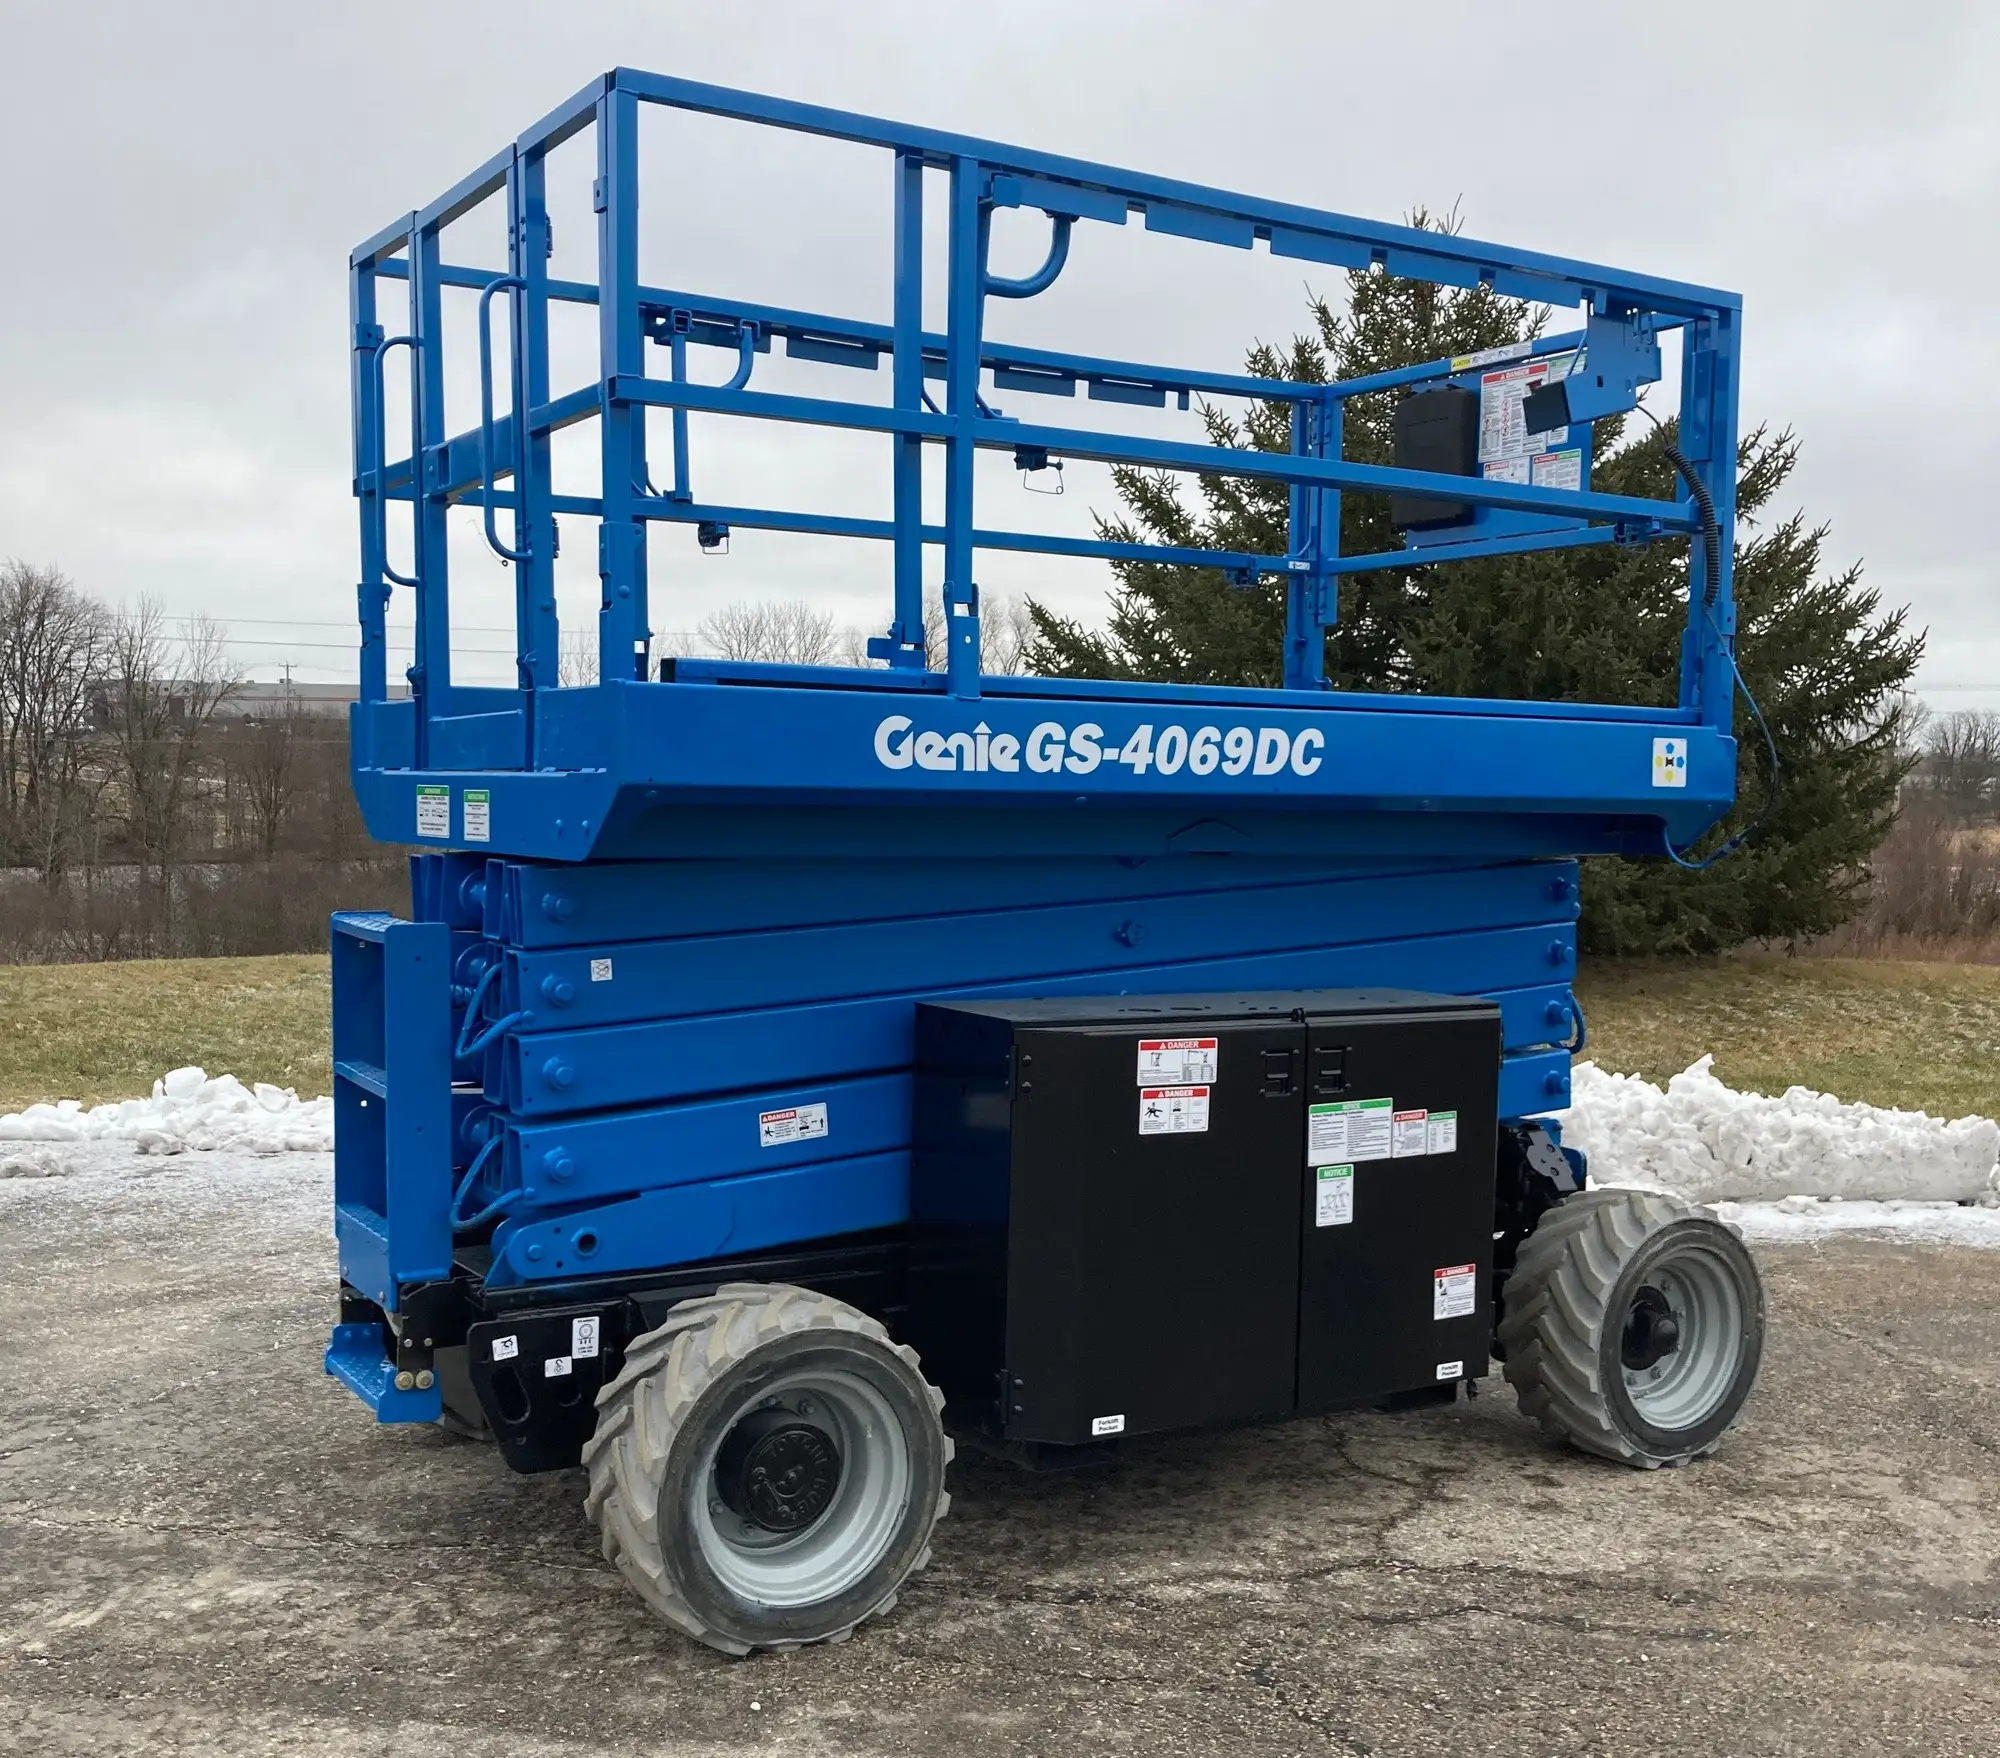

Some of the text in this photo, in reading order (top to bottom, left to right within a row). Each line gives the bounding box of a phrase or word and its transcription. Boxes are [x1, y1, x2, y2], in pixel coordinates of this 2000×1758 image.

[874, 715, 1325, 777] Genie GS-4069DC
[1167, 1041, 1200, 1050] DANGER
[1164, 1089, 1194, 1098] DANGER
[767, 1111, 796, 1122] DANGER
[1323, 1168, 1349, 1178] NOTICE
